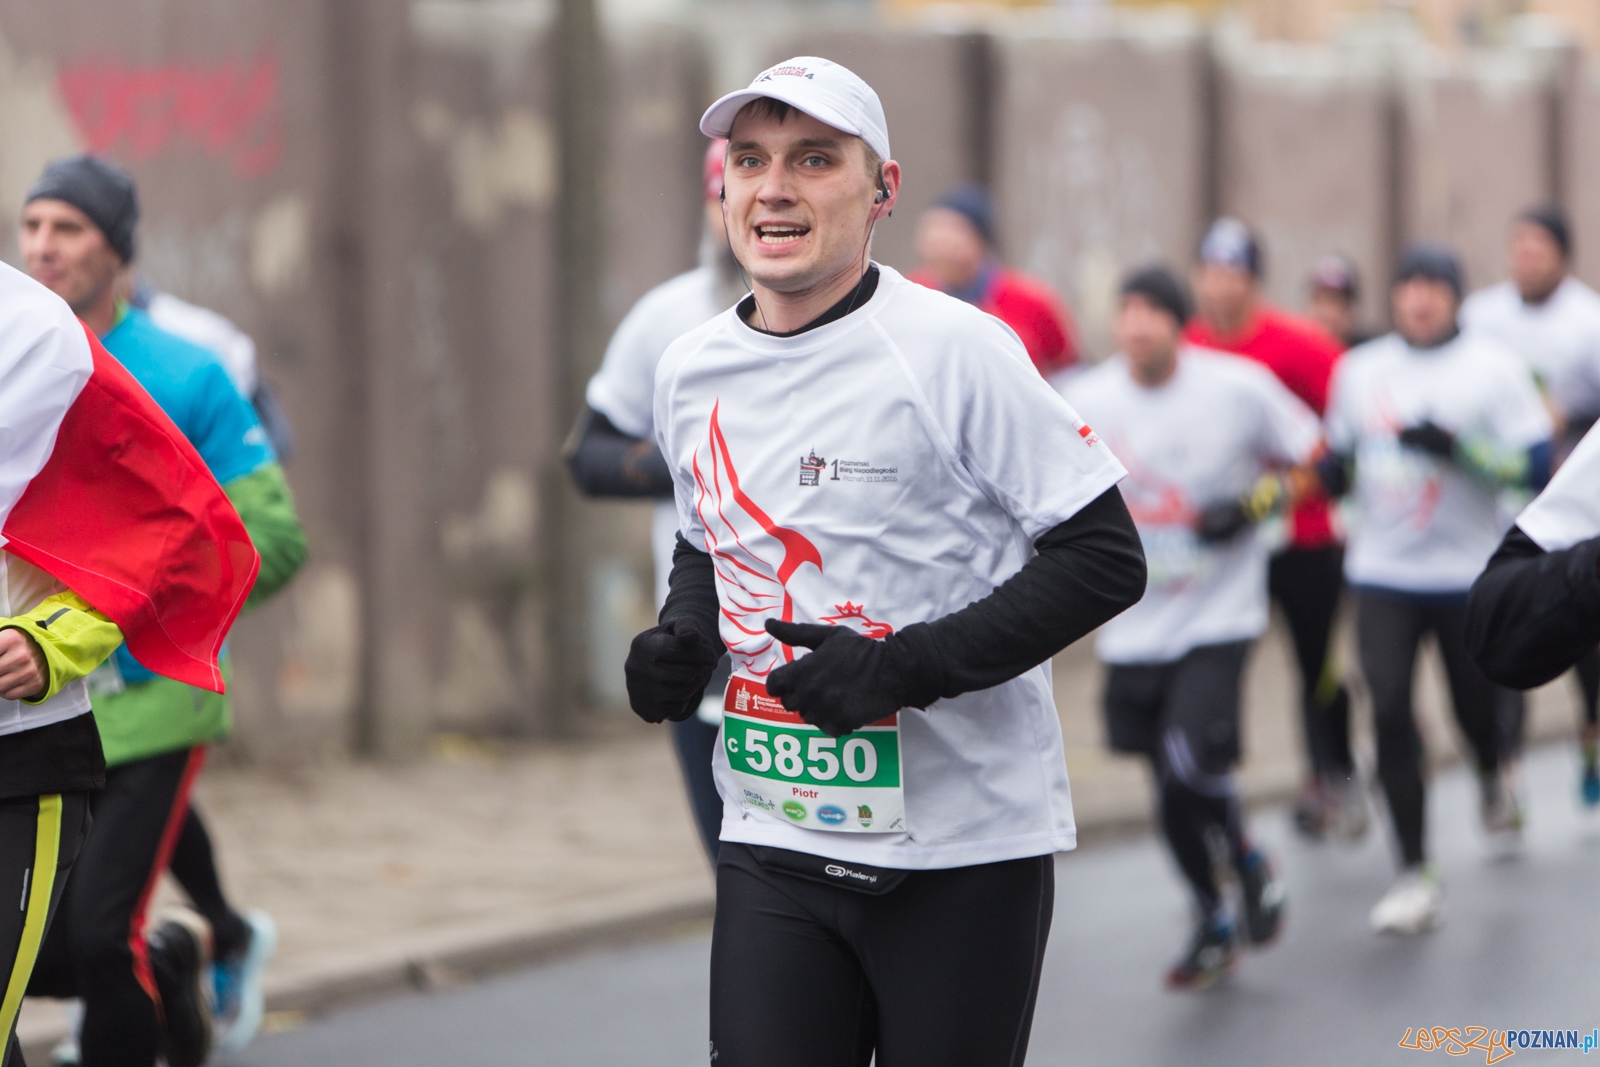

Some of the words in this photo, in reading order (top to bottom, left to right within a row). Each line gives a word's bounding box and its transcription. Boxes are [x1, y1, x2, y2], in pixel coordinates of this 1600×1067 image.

[830, 458, 841, 481] 1
[840, 459, 869, 467] Poznański
[840, 466, 853, 474] Bieg
[745, 728, 878, 782] 5850
[792, 787, 819, 799] Piotr
[845, 868, 877, 883] Kalenji
